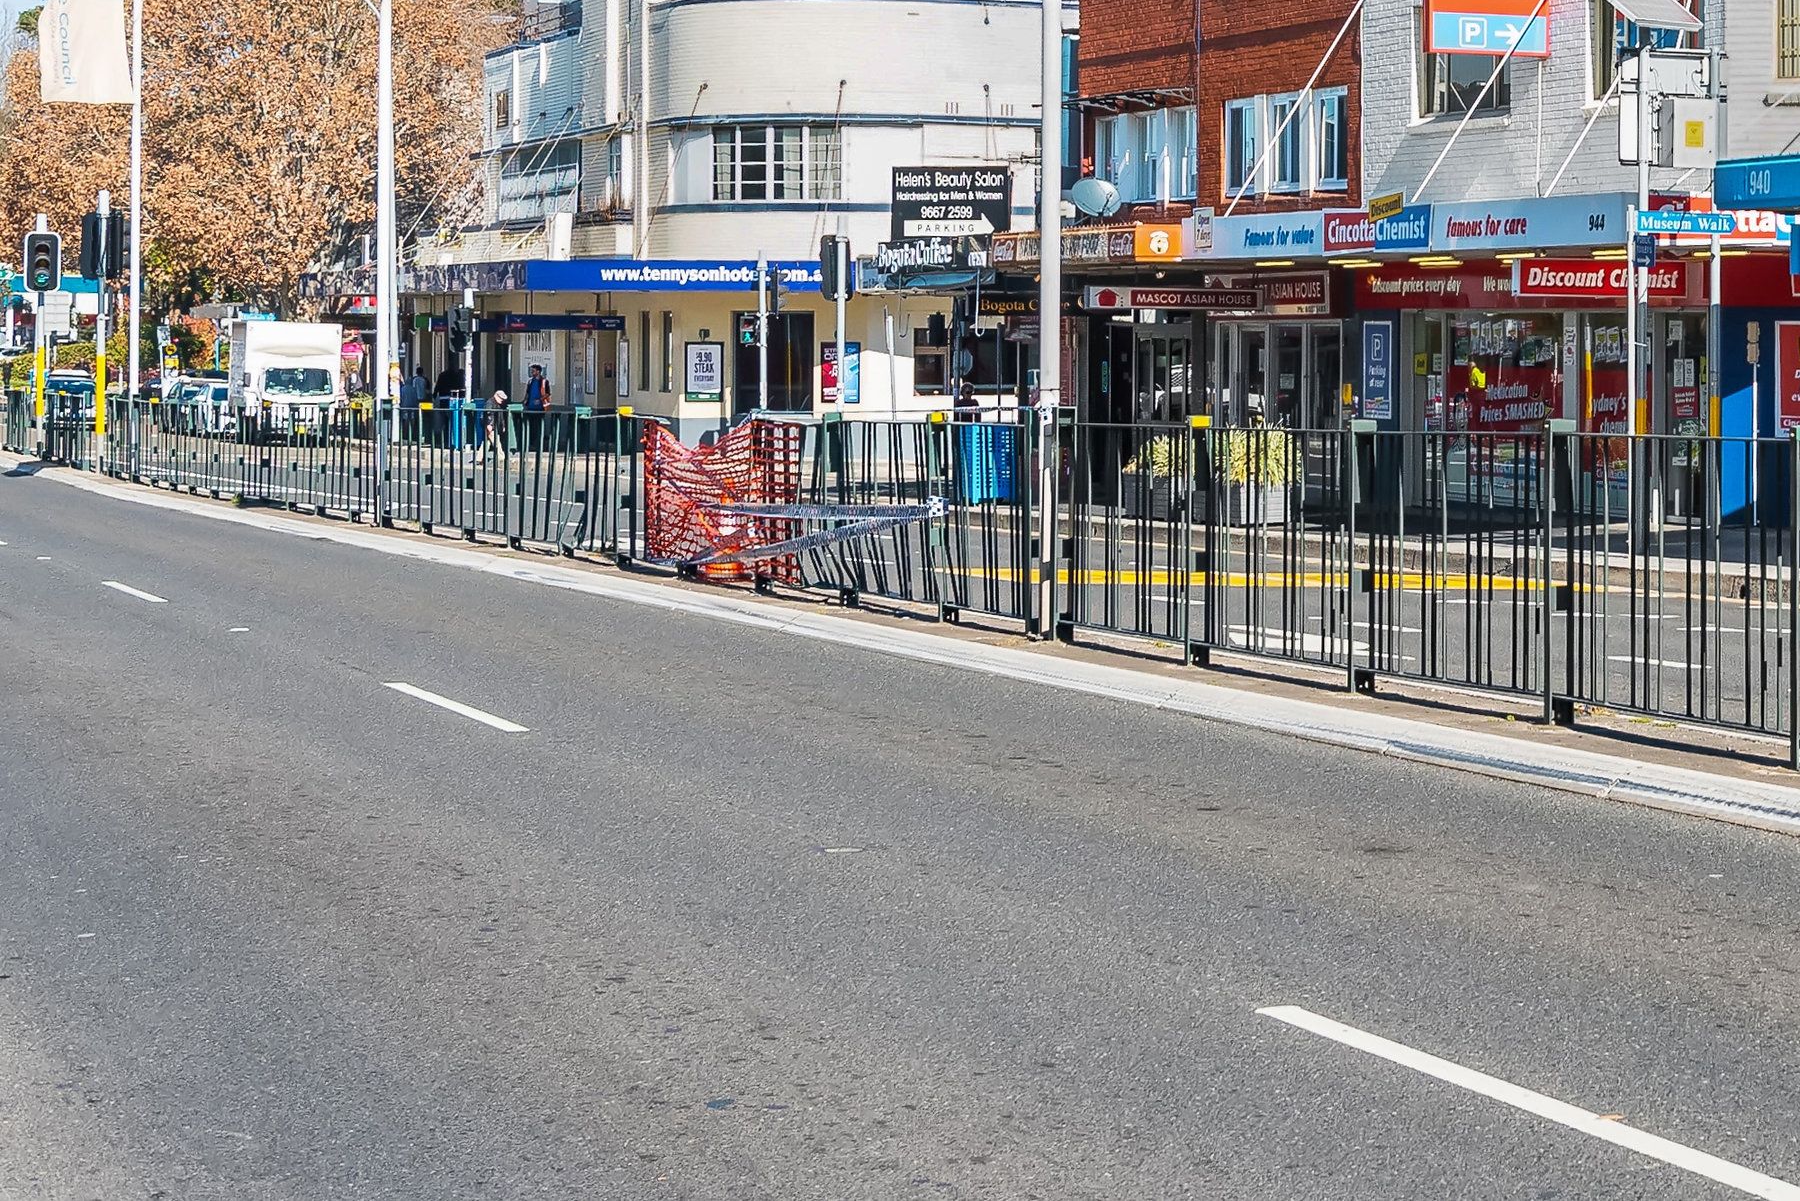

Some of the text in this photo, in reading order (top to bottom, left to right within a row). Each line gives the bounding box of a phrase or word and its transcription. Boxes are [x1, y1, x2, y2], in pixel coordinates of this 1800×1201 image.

[895, 171, 1004, 189] Helen's Beauty Salon
[1750, 168, 1771, 195] 940
[896, 191, 938, 202] Hairdressing
[940, 191, 950, 200] for
[975, 192, 1003, 200] Women
[921, 206, 972, 218] 9667 2599
[1371, 197, 1402, 217] Discount
[917, 224, 975, 232] PARKING
[1327, 214, 1426, 244] CincottaChemist
[1446, 213, 1606, 239] famous for care 944
[1640, 216, 1731, 231] Museum Walk
[1243, 225, 1315, 248] Famous for value
[1372, 278, 1401, 293] Discount
[1402, 279, 1424, 294] prices
[1425, 278, 1446, 293] every
[1447, 276, 1462, 295] day
[1527, 267, 1605, 288] Discount
[1136, 293, 1252, 305] MASCOT ASIAN HOUSE
[1270, 283, 1294, 299] ASIAN
[1295, 281, 1322, 299] HOUSE
[981, 298, 1025, 314] Bogota
[694, 362, 714, 373] STEAK
[1480, 402, 1545, 422] Prices SMASHED
[1592, 393, 1627, 417] ydney's
